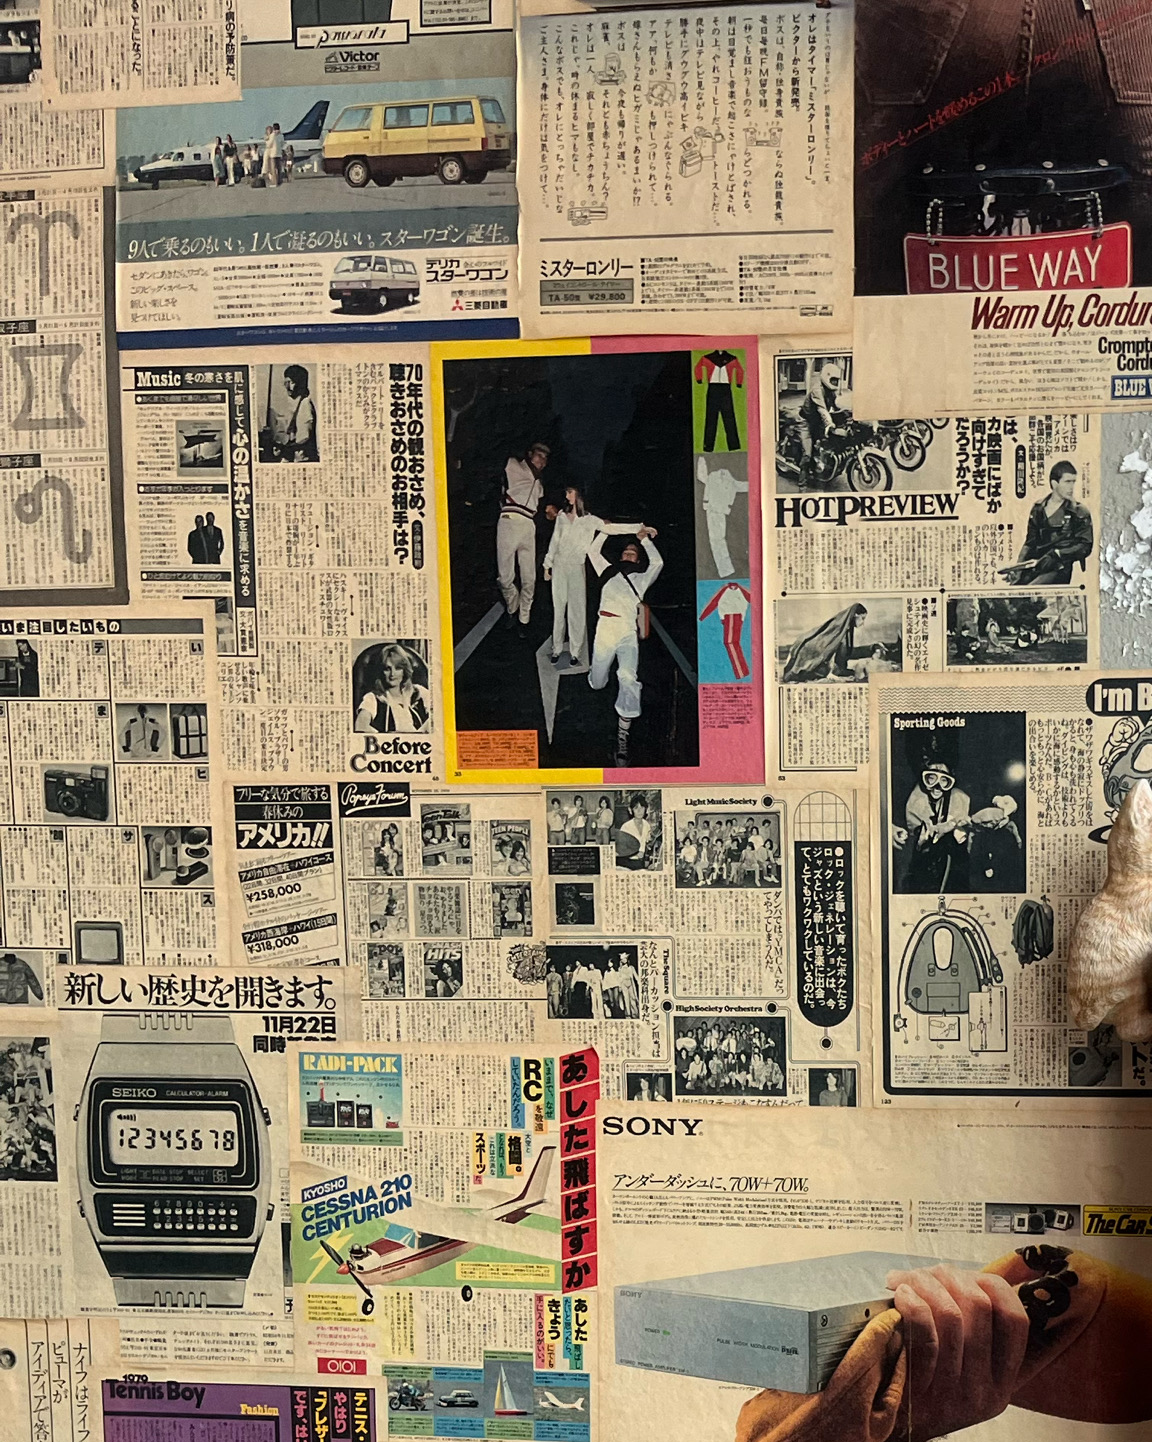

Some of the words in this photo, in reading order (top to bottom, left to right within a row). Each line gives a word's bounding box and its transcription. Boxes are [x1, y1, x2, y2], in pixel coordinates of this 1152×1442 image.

[339, 50, 380, 63] Victor
[539, 256, 634, 279] ミスターロンリー
[928, 252, 1019, 292] BLUE
[1027, 244, 1104, 287] WAY
[971, 298, 1038, 331] Warm
[1042, 296, 1075, 334] Up,
[137, 370, 182, 387] Music
[1113, 377, 1144, 397] BLUE
[1094, 682, 1131, 712] I'm
[893, 716, 935, 730] Sporting
[936, 715, 966, 729] Goods
[364, 735, 432, 756] Before
[350, 755, 432, 775] Concert
[685, 797, 706, 806] Light
[729, 797, 758, 807] Society
[246, 882, 302, 904] ¥258,000
[64, 973, 338, 1012] 新しい歴史を開きます。
[675, 1004, 694, 1014] High
[695, 1004, 721, 1014] Society
[724, 1004, 763, 1014] Orchestra
[262, 1016, 337, 1035] 11月22日
[303, 1053, 399, 1074] RADI-PACK
[522, 1058, 543, 1102] RC
[112, 1087, 157, 1098] SEIKO
[602, 1116, 703, 1137] SONY
[119, 1127, 236, 1152] 12345678
[561, 1053, 594, 1292] あした飛ばすか
[301, 1184, 379, 1223] CESSNA
[380, 1173, 413, 1200] 210
[303, 1178, 347, 1202] KYOSHO
[302, 1191, 413, 1242] CENTURION
[123, 1375, 148, 1384] 1979
[107, 1381, 164, 1400] Tennis
[166, 1381, 207, 1409] Boy
[240, 1403, 280, 1416] Fashion
[333, 1391, 348, 1435] やはり
